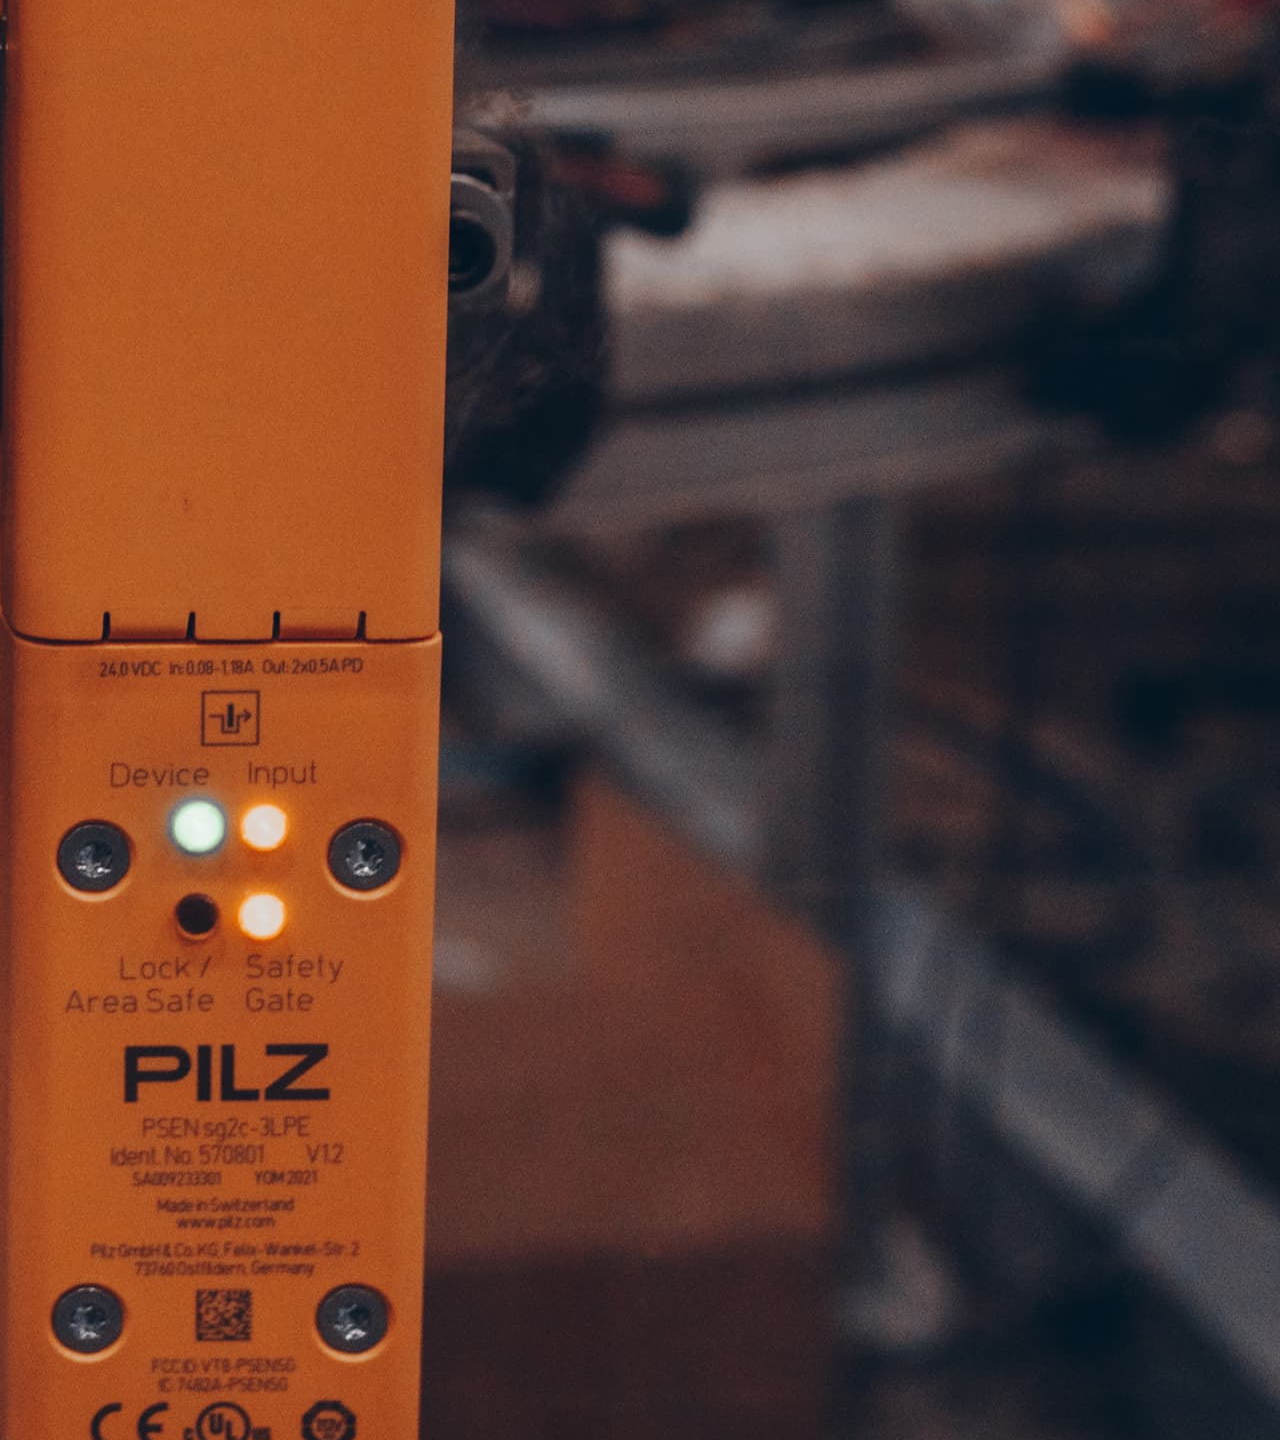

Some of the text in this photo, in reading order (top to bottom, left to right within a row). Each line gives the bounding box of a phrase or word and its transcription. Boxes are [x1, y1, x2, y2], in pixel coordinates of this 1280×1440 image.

[99, 660, 129, 678] 24.0
[131, 660, 161, 676] VDC
[341, 657, 364, 674] PD
[109, 762, 210, 789] Device
[247, 760, 318, 790] Input
[119, 956, 189, 982] Lock
[246, 953, 345, 984] Safety
[64, 988, 215, 1014] Area Safe
[245, 986, 314, 1012] Gate
[124, 1044, 330, 1103] PILZ
[142, 1117, 199, 1138] PSEN
[199, 1144, 265, 1165] 570801
[210, 1197, 295, 1212] Switzerland
